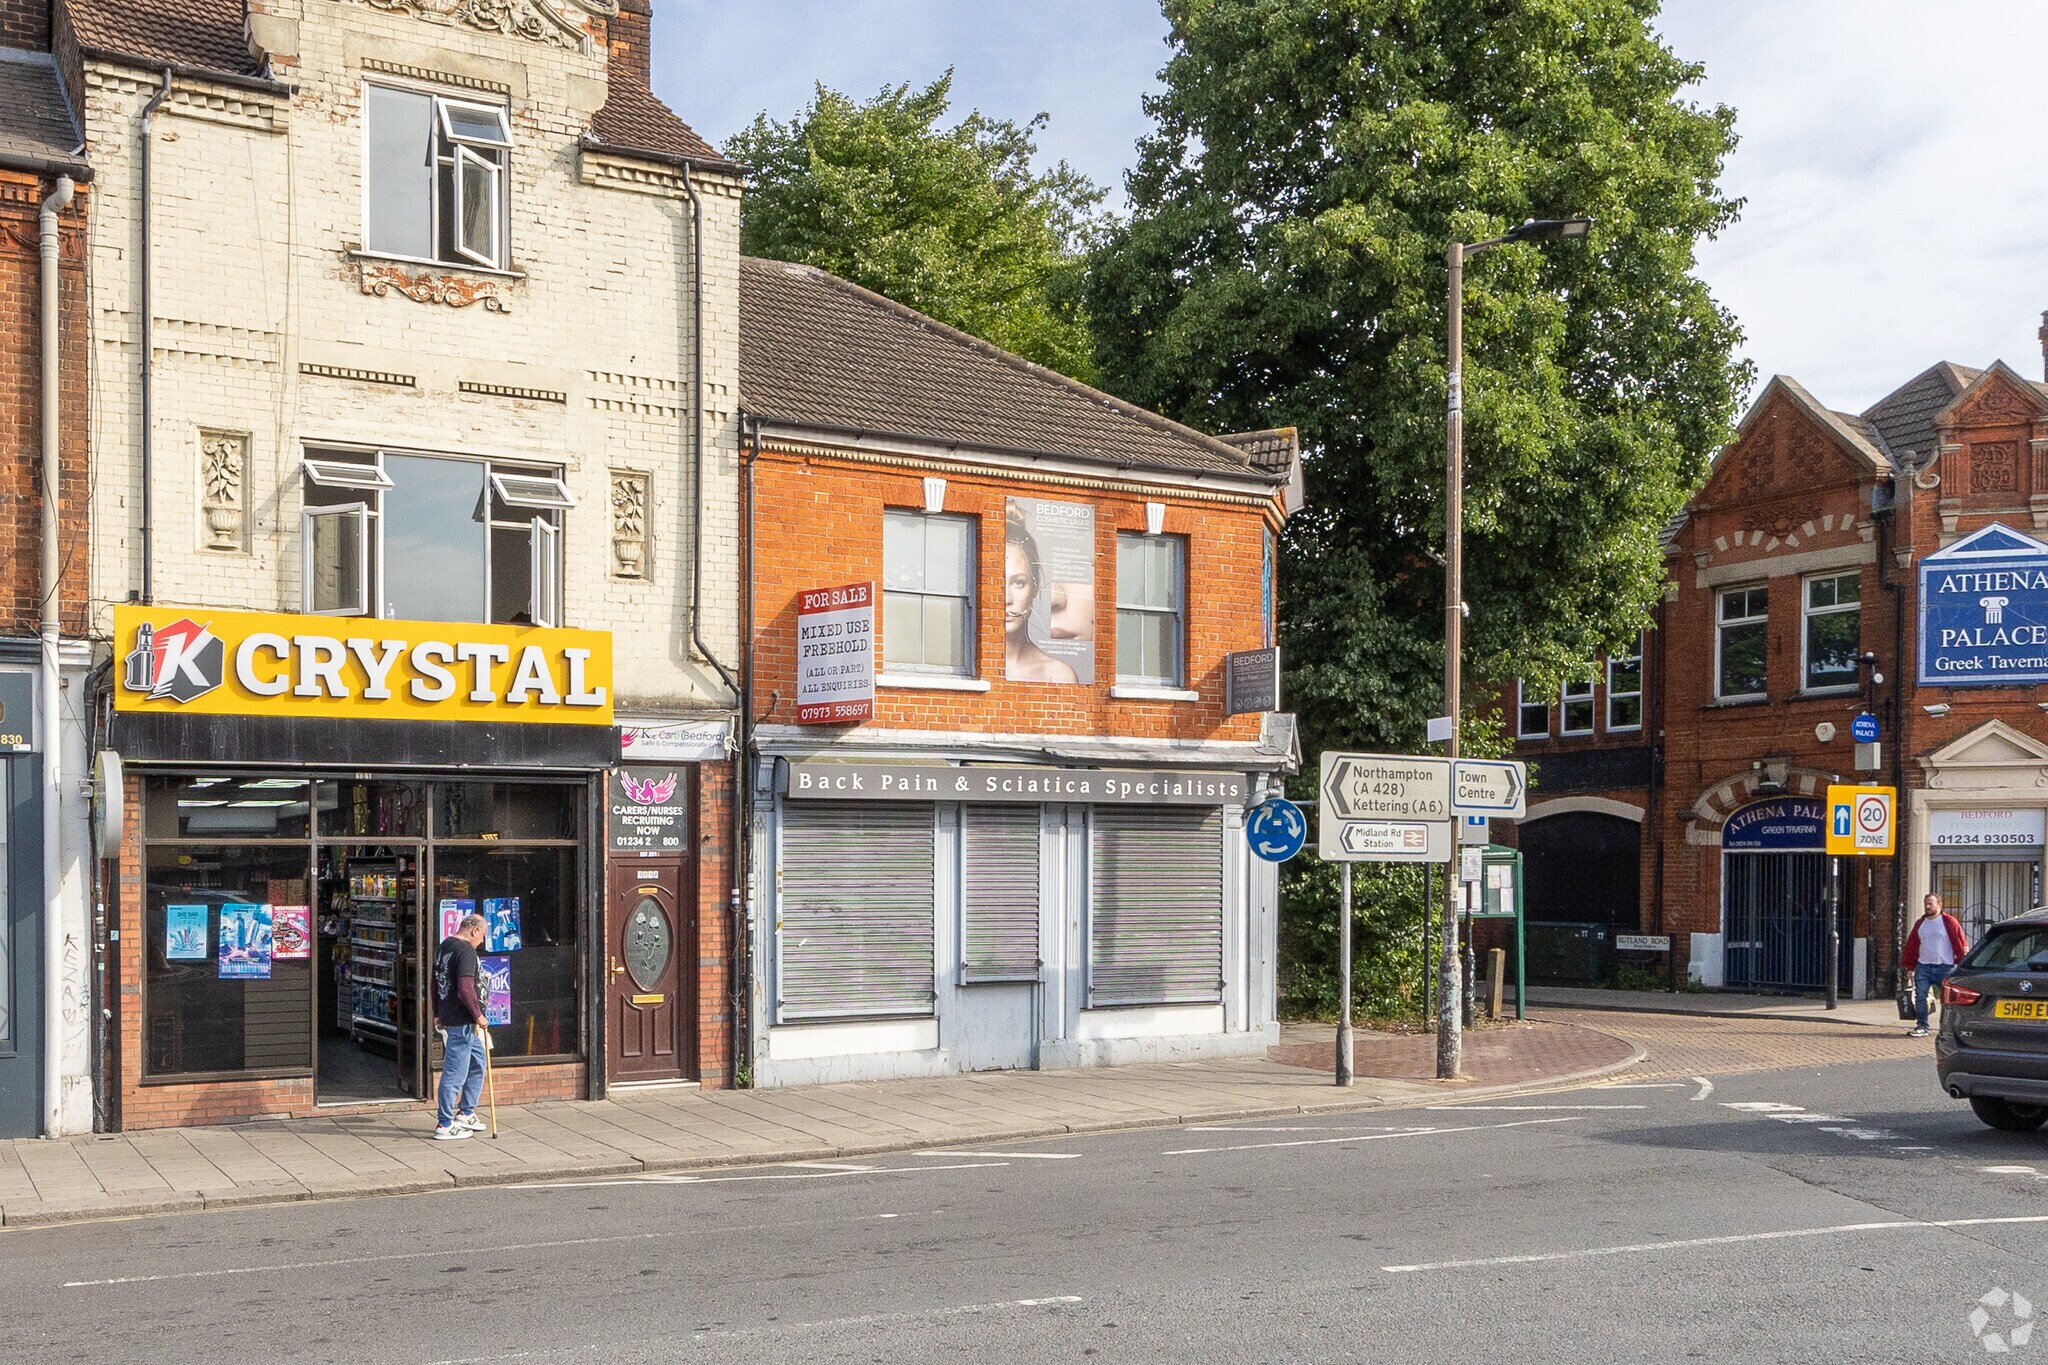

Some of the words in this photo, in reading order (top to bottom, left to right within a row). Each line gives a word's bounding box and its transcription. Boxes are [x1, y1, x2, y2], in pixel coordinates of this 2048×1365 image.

[1036, 503, 1090, 519] BEDFORD
[1069, 518, 1090, 527] LASER
[1938, 570, 2048, 594] ATHENA
[803, 592, 830, 610] FOR
[831, 586, 868, 606] SALE
[801, 623, 843, 641] MIXED
[845, 619, 870, 635] USE
[1940, 625, 2047, 649] PALACE
[803, 638, 868, 658] FREEHOLD
[1233, 652, 1274, 667] BEDFORD
[1935, 655, 1984, 671] Greek
[235, 631, 607, 707] CRYSTAL
[806, 666, 826, 679] (ALL
[827, 665, 839, 676] OR
[840, 662, 865, 675] PART)
[802, 683, 819, 694] ALL
[801, 706, 831, 720] 07973
[835, 703, 870, 717] 558697
[1855, 720, 1876, 729] ATHENA
[0, 734, 23, 745] 830
[659, 730, 681, 740] Care
[681, 729, 726, 742] (Bedford)
[1855, 729, 1875, 737] PALACE
[1353, 765, 1433, 782] Northampton
[1458, 770, 1487, 784] Town
[798, 772, 864, 790] Back
[881, 773, 938, 791] Pain
[954, 775, 970, 792] &
[985, 775, 1091, 794] Sciatica
[1105, 779, 1239, 799] Specialists
[1458, 785, 1496, 800] Centre
[612, 805, 684, 817] CARERS/NURSES
[1353, 798, 1409, 814] Kettering
[621, 815, 675, 826] RECRUITING
[1730, 804, 1786, 835] ATHENA
[1863, 807, 1883, 822] 20
[1961, 810, 2013, 820] BEDFORD
[636, 825, 661, 836] NOW
[1355, 827, 1388, 837] Midland
[1391, 828, 1401, 837] Rd
[1761, 825, 1785, 835] GREEK
[1786, 824, 1817, 834] TAVERNA
[1950, 821, 2024, 831] FURNISHINGS
[616, 836, 644, 846] 01234
[1363, 838, 1394, 848] Station
[1859, 835, 1884, 845] ZONE
[1937, 834, 1980, 844] 01234
[1984, 833, 2035, 844] 930503
[1618, 936, 1648, 945] RUTLAND
[1650, 937, 1669, 945] ROAD
[490, 971, 511, 991] 10K
[2003, 1002, 2033, 1017] SH19
